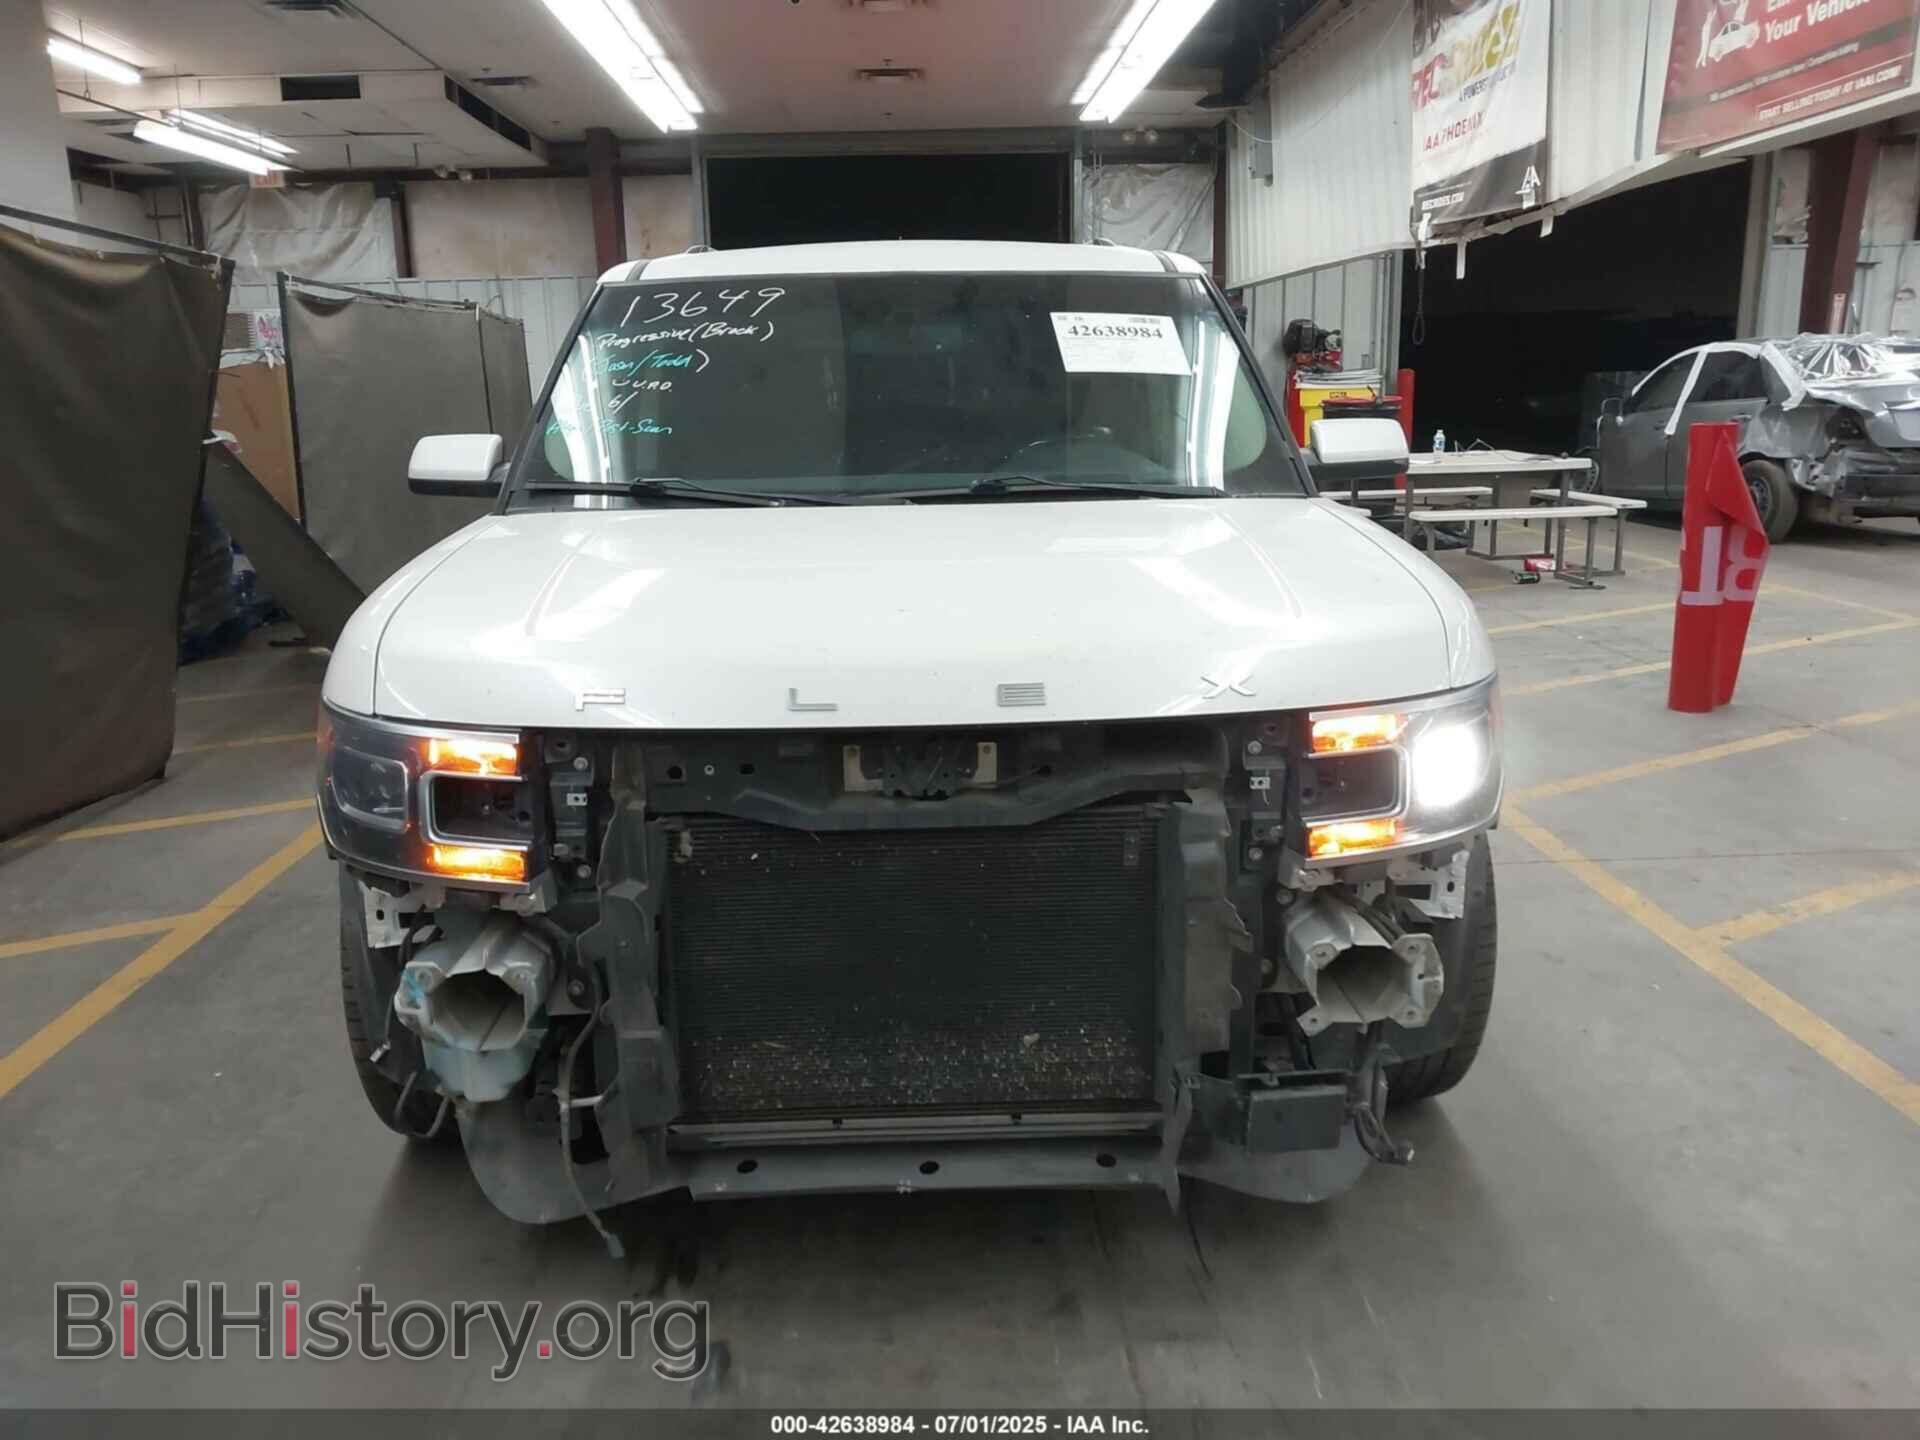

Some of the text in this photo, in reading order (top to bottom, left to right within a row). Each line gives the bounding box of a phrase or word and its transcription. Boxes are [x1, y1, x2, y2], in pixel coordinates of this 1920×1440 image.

[1766, 14, 1802, 43] Your
[619, 286, 786, 328] 13649
[1067, 324, 1164, 339] 42638984
